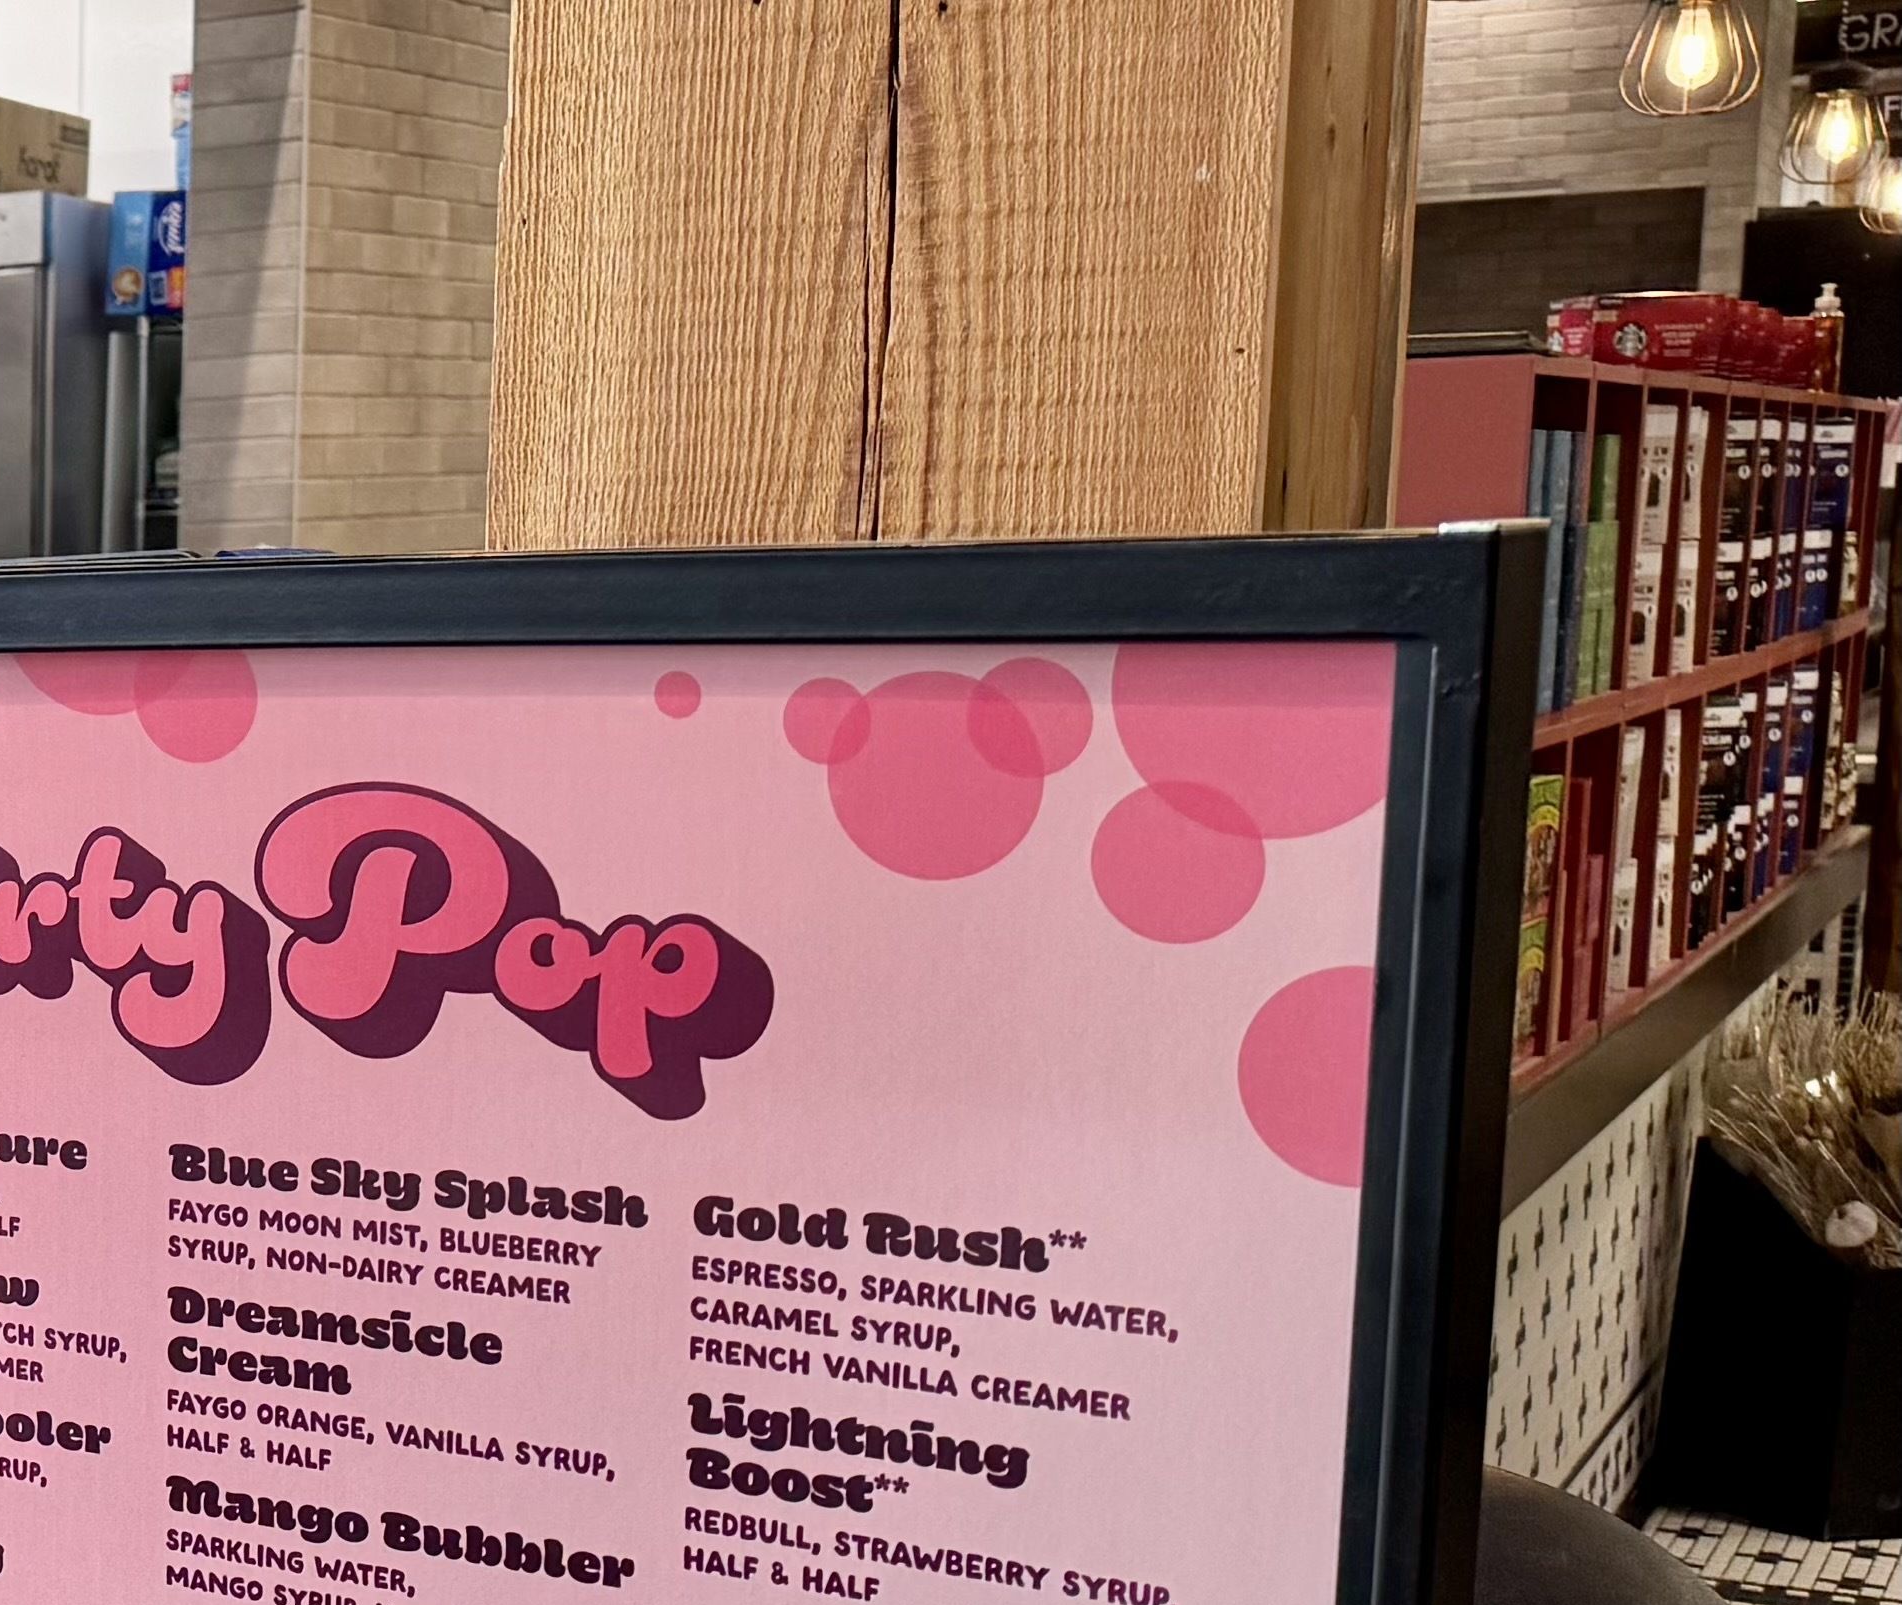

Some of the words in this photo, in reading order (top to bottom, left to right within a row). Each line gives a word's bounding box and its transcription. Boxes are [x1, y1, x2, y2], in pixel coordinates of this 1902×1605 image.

[1838, 12, 1902, 52] GR
[254, 780, 776, 1121] Pop
[168, 1143, 300, 1192] Blue
[310, 1157, 422, 1212] Sky
[433, 1169, 649, 1229] Splash
[693, 1195, 849, 1251] Gold
[167, 1234, 256, 1271] SYRUP,
[266, 1246, 425, 1286] NON-DAIRY
[433, 1266, 571, 1305] CREAMER
[168, 1198, 249, 1228] FAYGO
[259, 1209, 342, 1239] MOON
[352, 1219, 429, 1253] MIST,
[439, 1227, 603, 1268] BLUEBERRY
[166, 1285, 503, 1366] Dreamsicle
[691, 1255, 847, 1302] ESPRESSO,
[860, 1274, 1037, 1321] SPARKLING
[1049, 1298, 1179, 1344] WATER,
[43, 1327, 127, 1364] SYRUP,
[167, 1335, 352, 1396] Cream
[687, 1392, 1031, 1490] Lightning
[165, 1474, 370, 1544] Mango
[380, 1511, 635, 1589] Bubbler
[684, 1506, 822, 1556] REDBULL,
[833, 1530, 1051, 1591] STRAWBERRY
